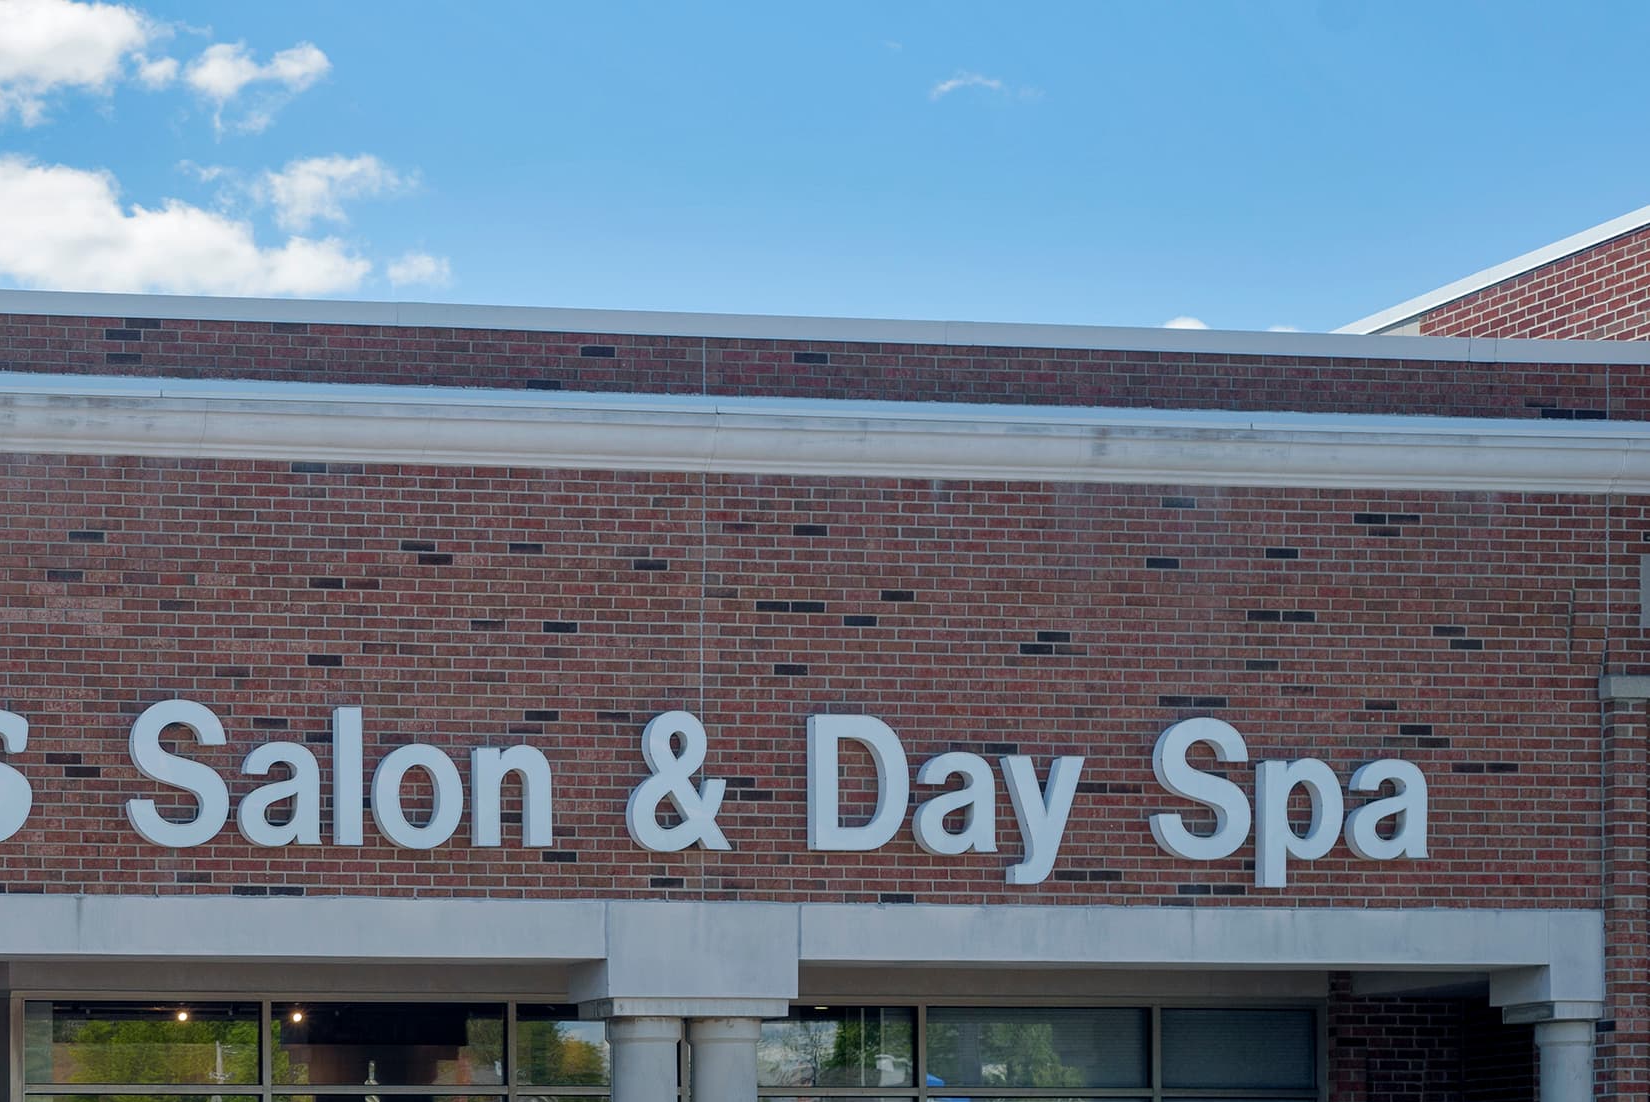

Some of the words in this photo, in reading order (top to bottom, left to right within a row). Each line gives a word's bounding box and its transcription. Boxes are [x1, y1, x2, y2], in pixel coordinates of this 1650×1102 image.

[124, 698, 555, 851] Salon
[625, 709, 732, 853] &
[805, 712, 1086, 886] Day
[1148, 716, 1430, 889] Spa
